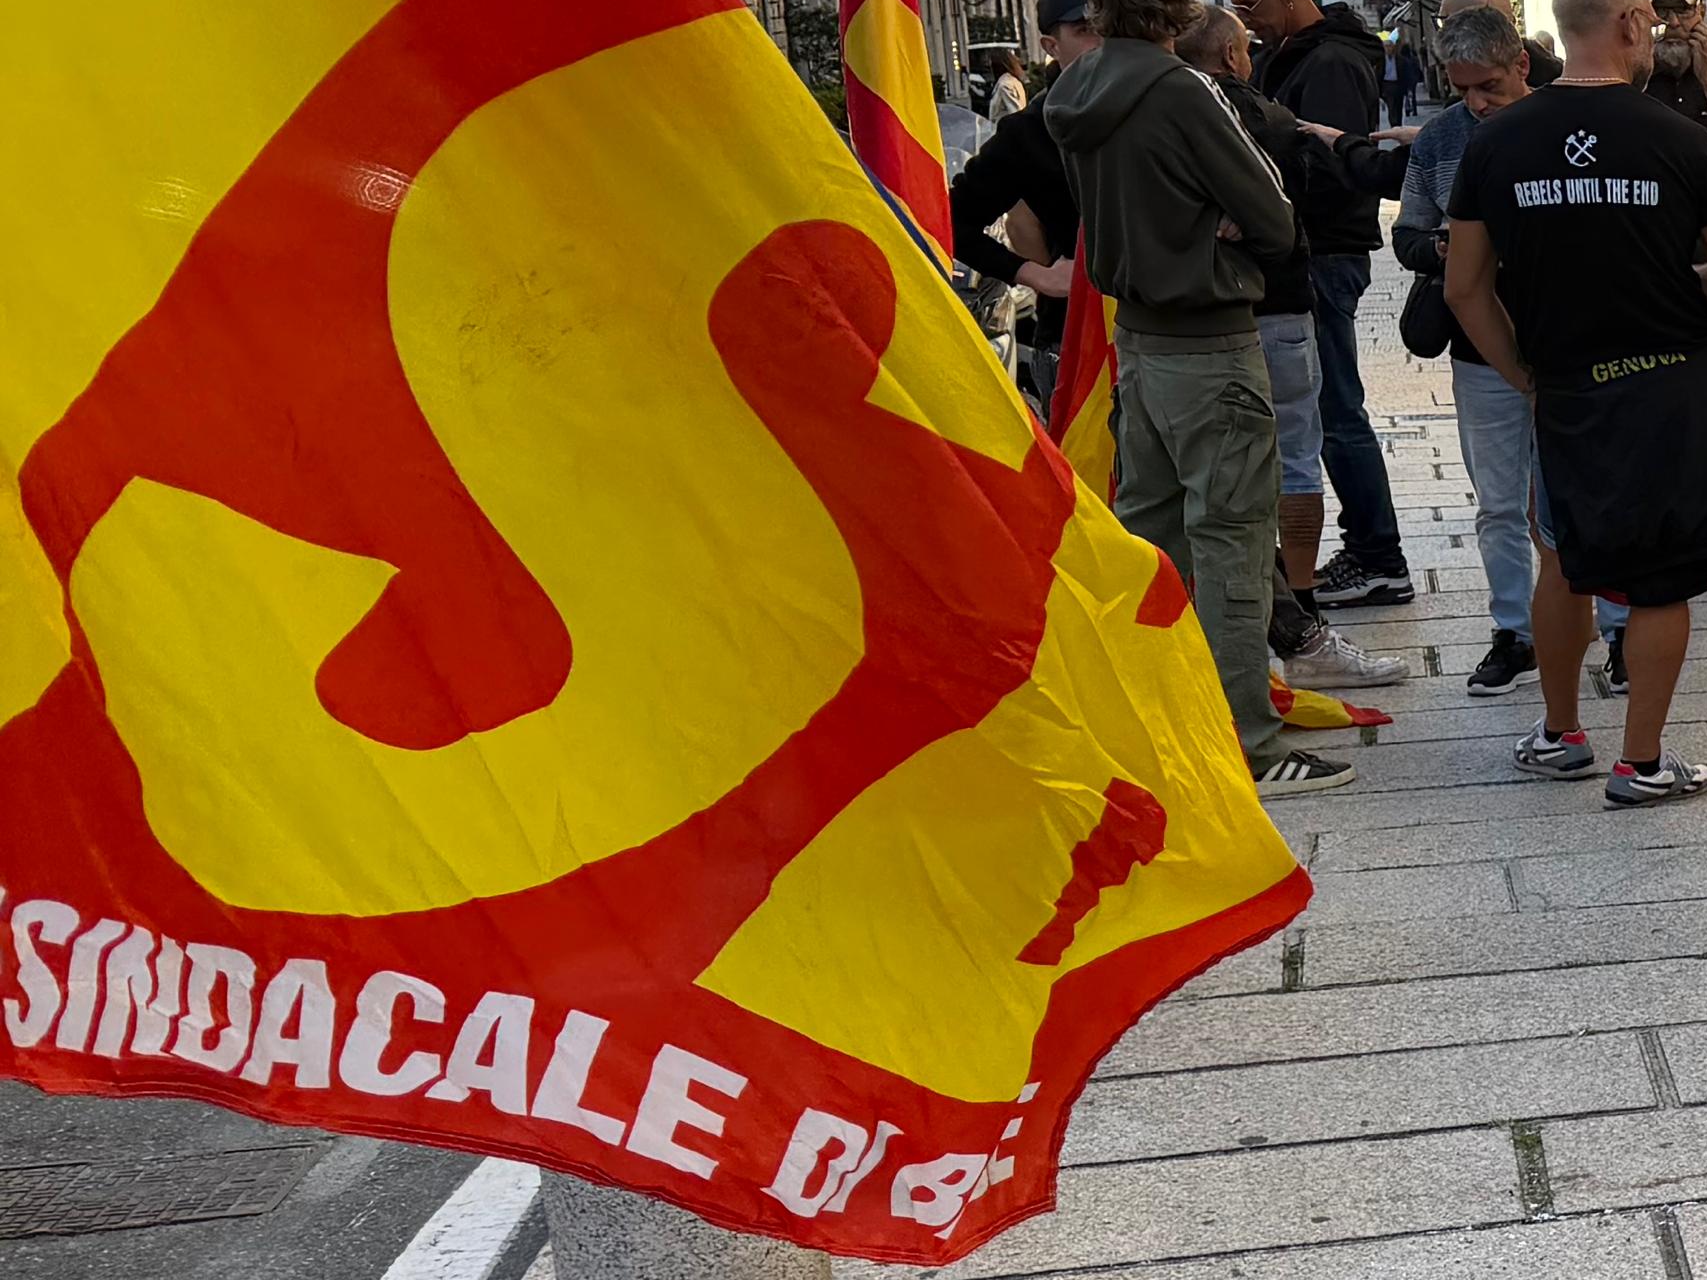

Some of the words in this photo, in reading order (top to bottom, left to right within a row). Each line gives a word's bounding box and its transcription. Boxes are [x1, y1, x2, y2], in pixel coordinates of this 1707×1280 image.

[1513, 179, 1563, 208] REBELS
[1565, 178, 1602, 204] UNTIL
[1605, 178, 1629, 204] THE
[1633, 180, 1659, 206] END
[2, 899, 747, 1180] SINDACALE
[760, 1107, 905, 1218] DI
